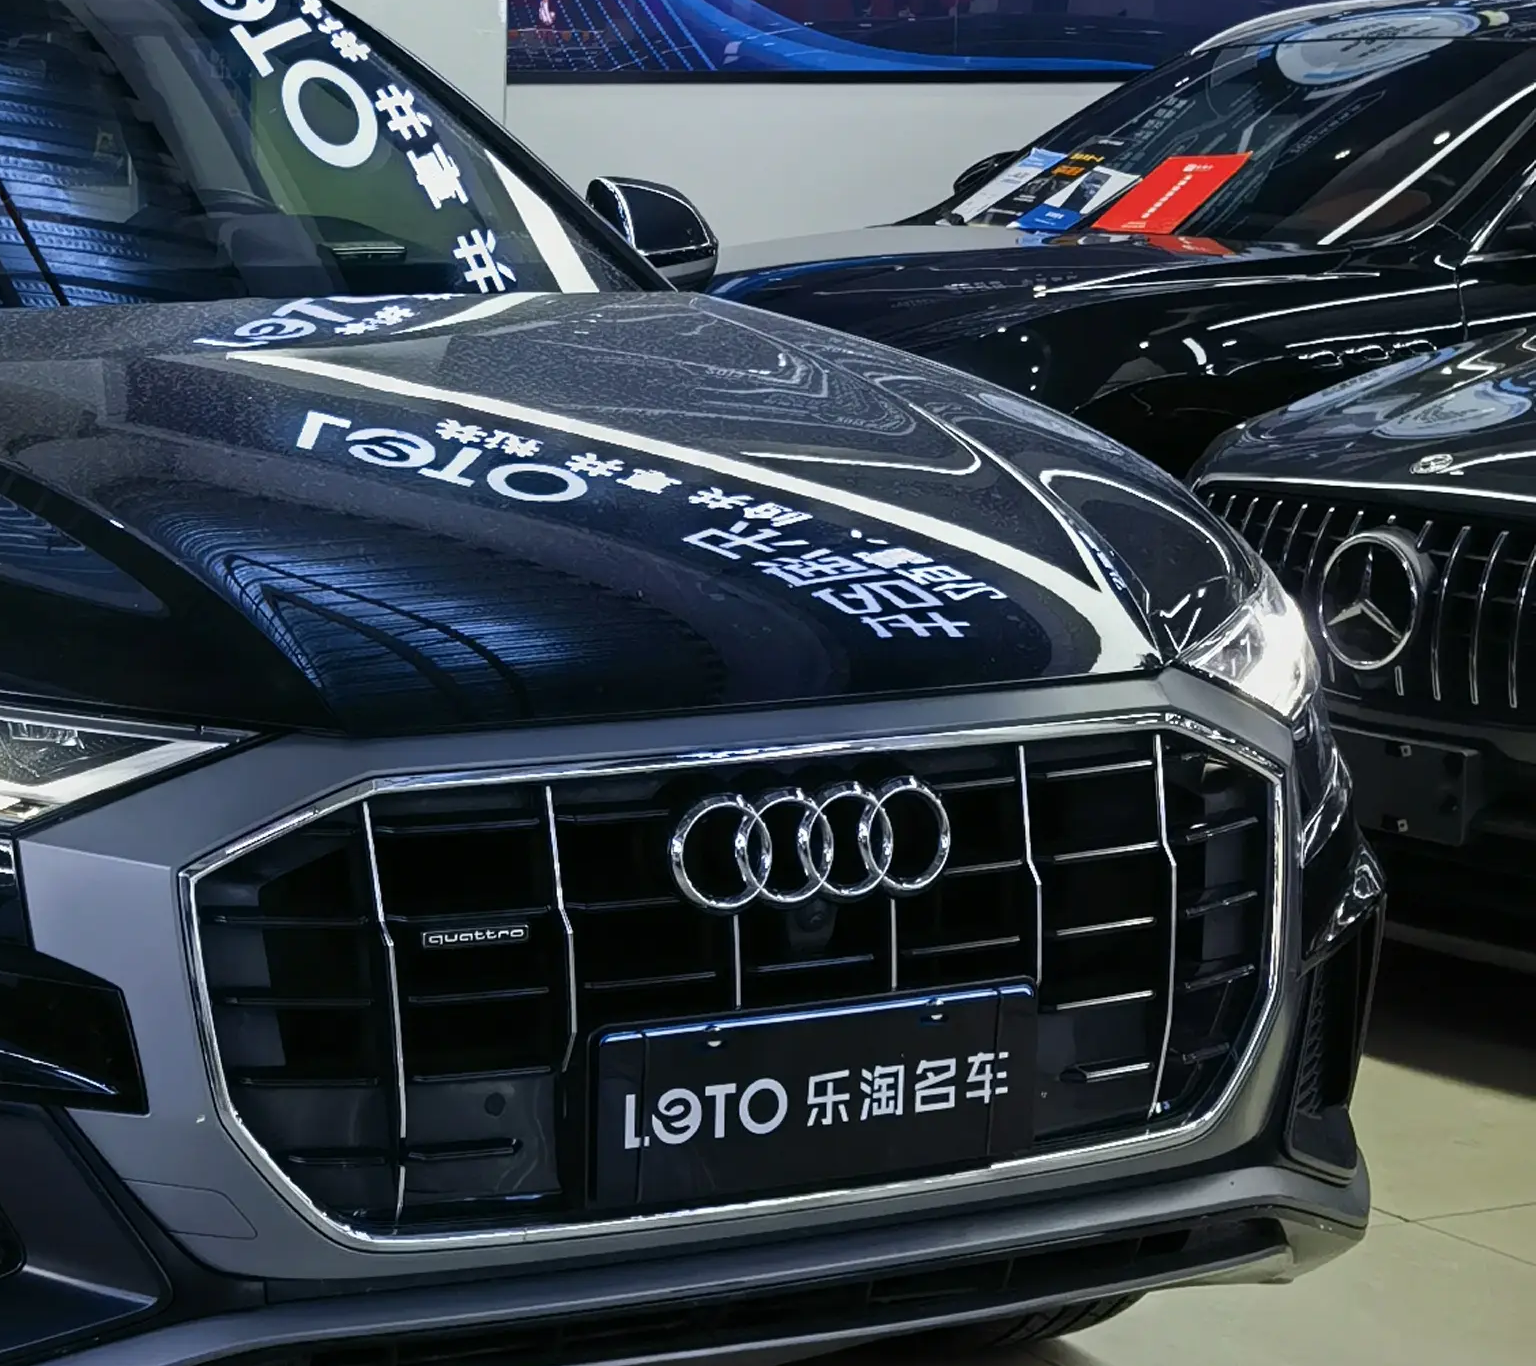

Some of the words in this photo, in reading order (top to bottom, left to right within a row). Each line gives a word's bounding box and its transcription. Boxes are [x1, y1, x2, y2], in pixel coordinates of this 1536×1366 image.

[427, 928, 525, 945] quattro
[624, 1077, 789, 1150] LOTO
[806, 1051, 1010, 1127] 乐淘名车
